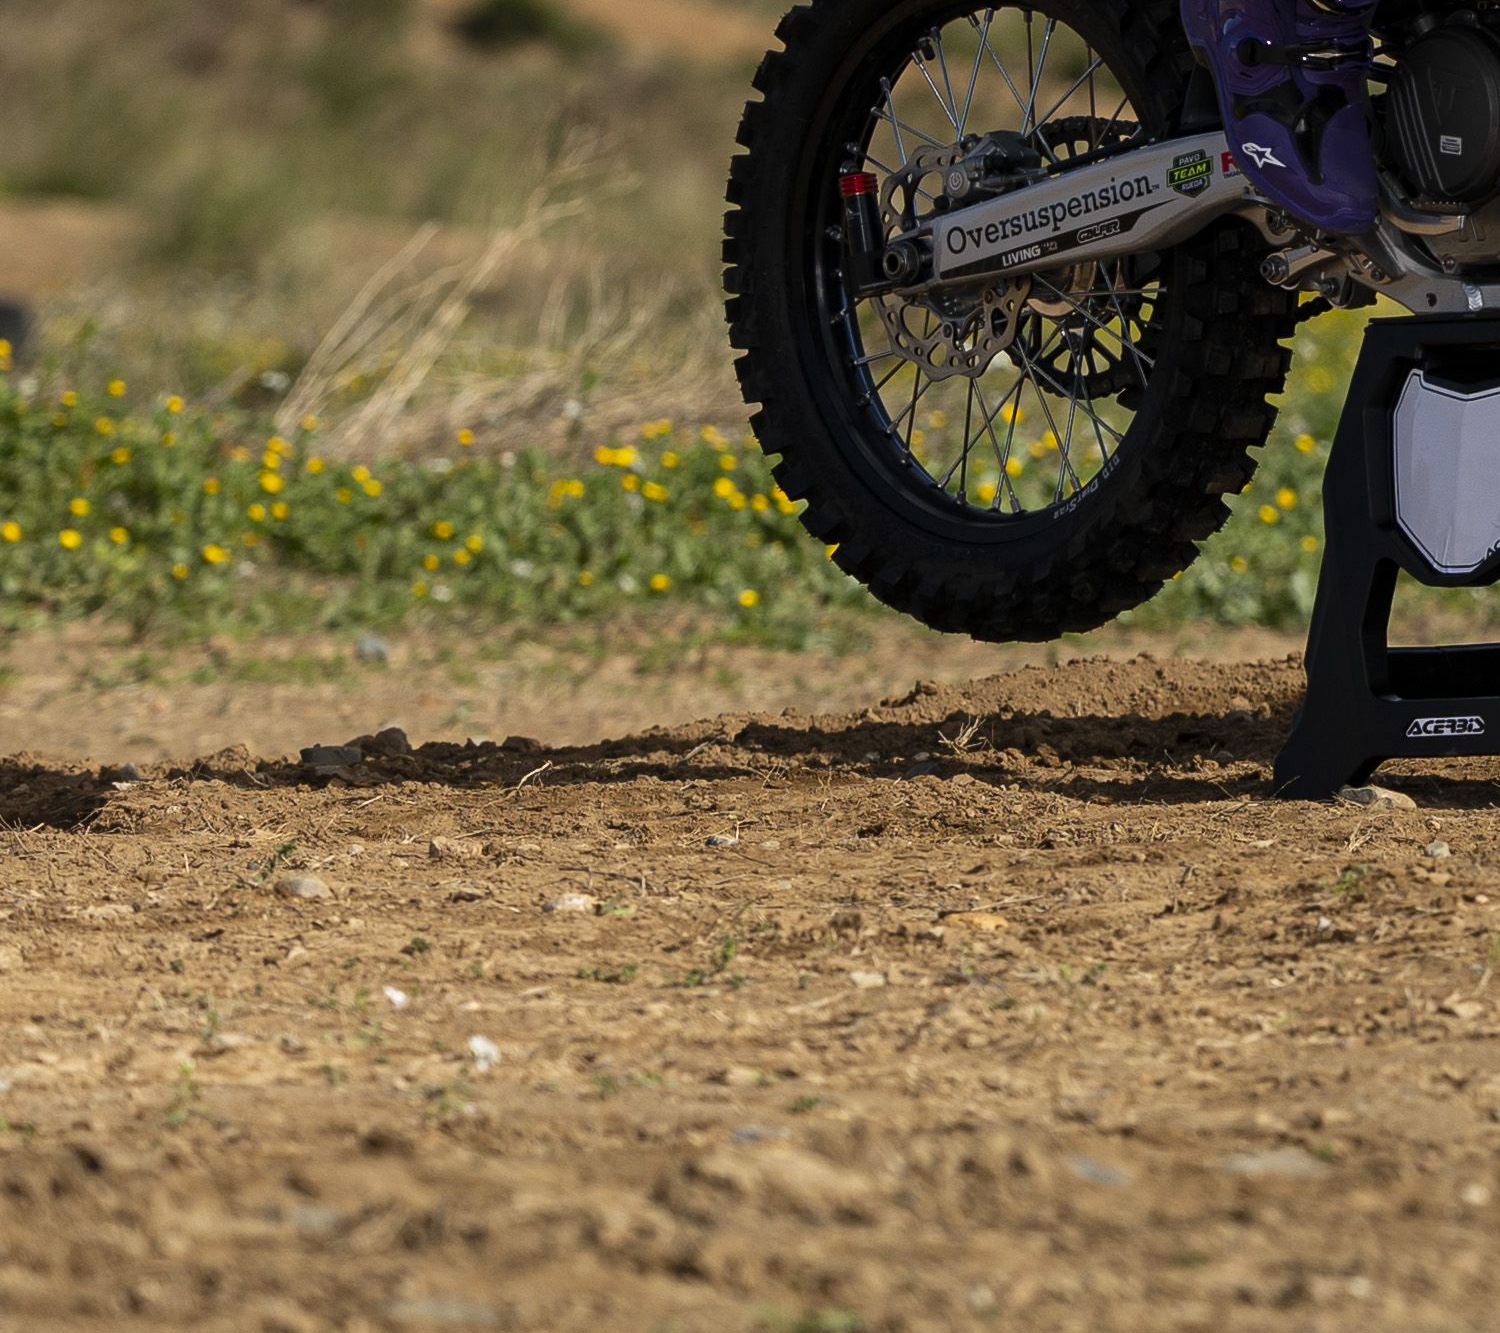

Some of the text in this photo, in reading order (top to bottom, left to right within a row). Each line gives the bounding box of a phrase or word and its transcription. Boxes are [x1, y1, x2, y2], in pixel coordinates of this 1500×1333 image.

[1178, 153, 1201, 166] PAVO
[1172, 163, 1208, 181] TEAM
[947, 174, 1153, 254] Oversuspension
[1002, 244, 1041, 268] LIVING
[1404, 716, 1486, 737] ACERBIS
